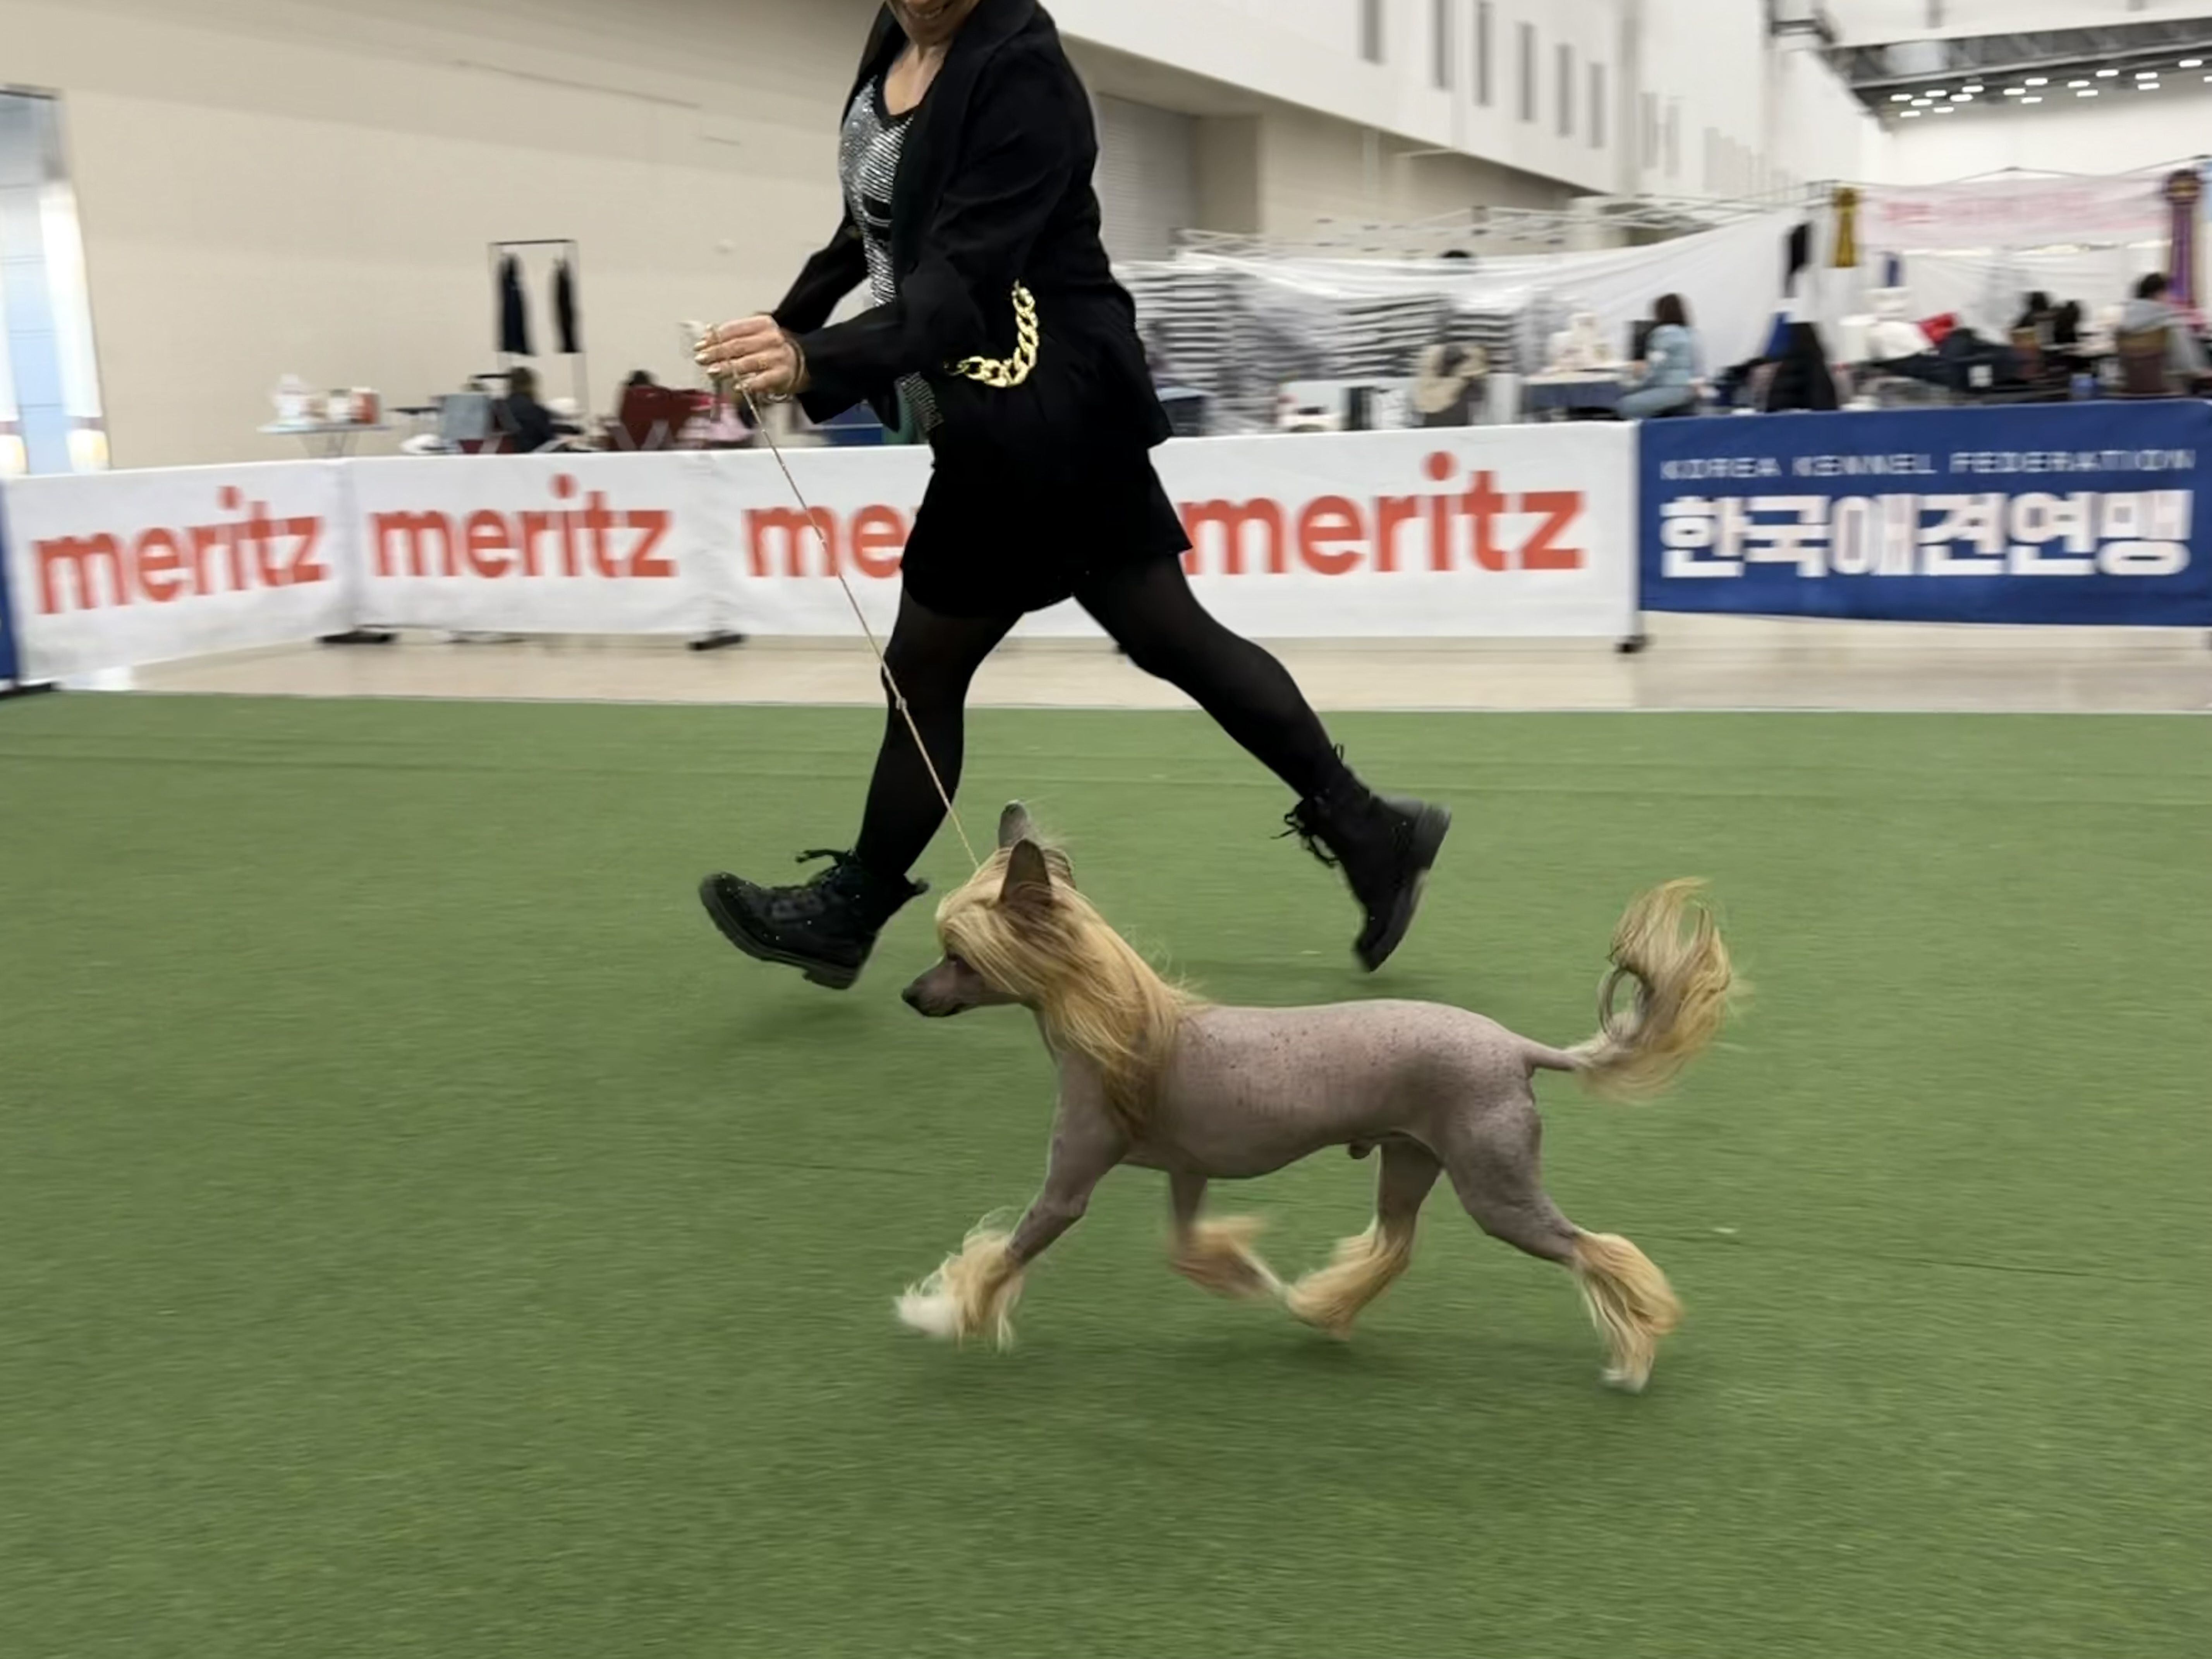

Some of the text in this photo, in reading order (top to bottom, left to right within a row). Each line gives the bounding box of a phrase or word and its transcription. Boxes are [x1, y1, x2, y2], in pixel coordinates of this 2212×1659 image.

[1661, 449, 2196, 479] KOREA KENNEL FEDERATION
[33, 486, 330, 614] meritz
[370, 474, 678, 578] meritz
[743, 504, 916, 579] me
[1179, 451, 1583, 576] meritz
[1660, 490, 2193, 578] 한국애견연맹
